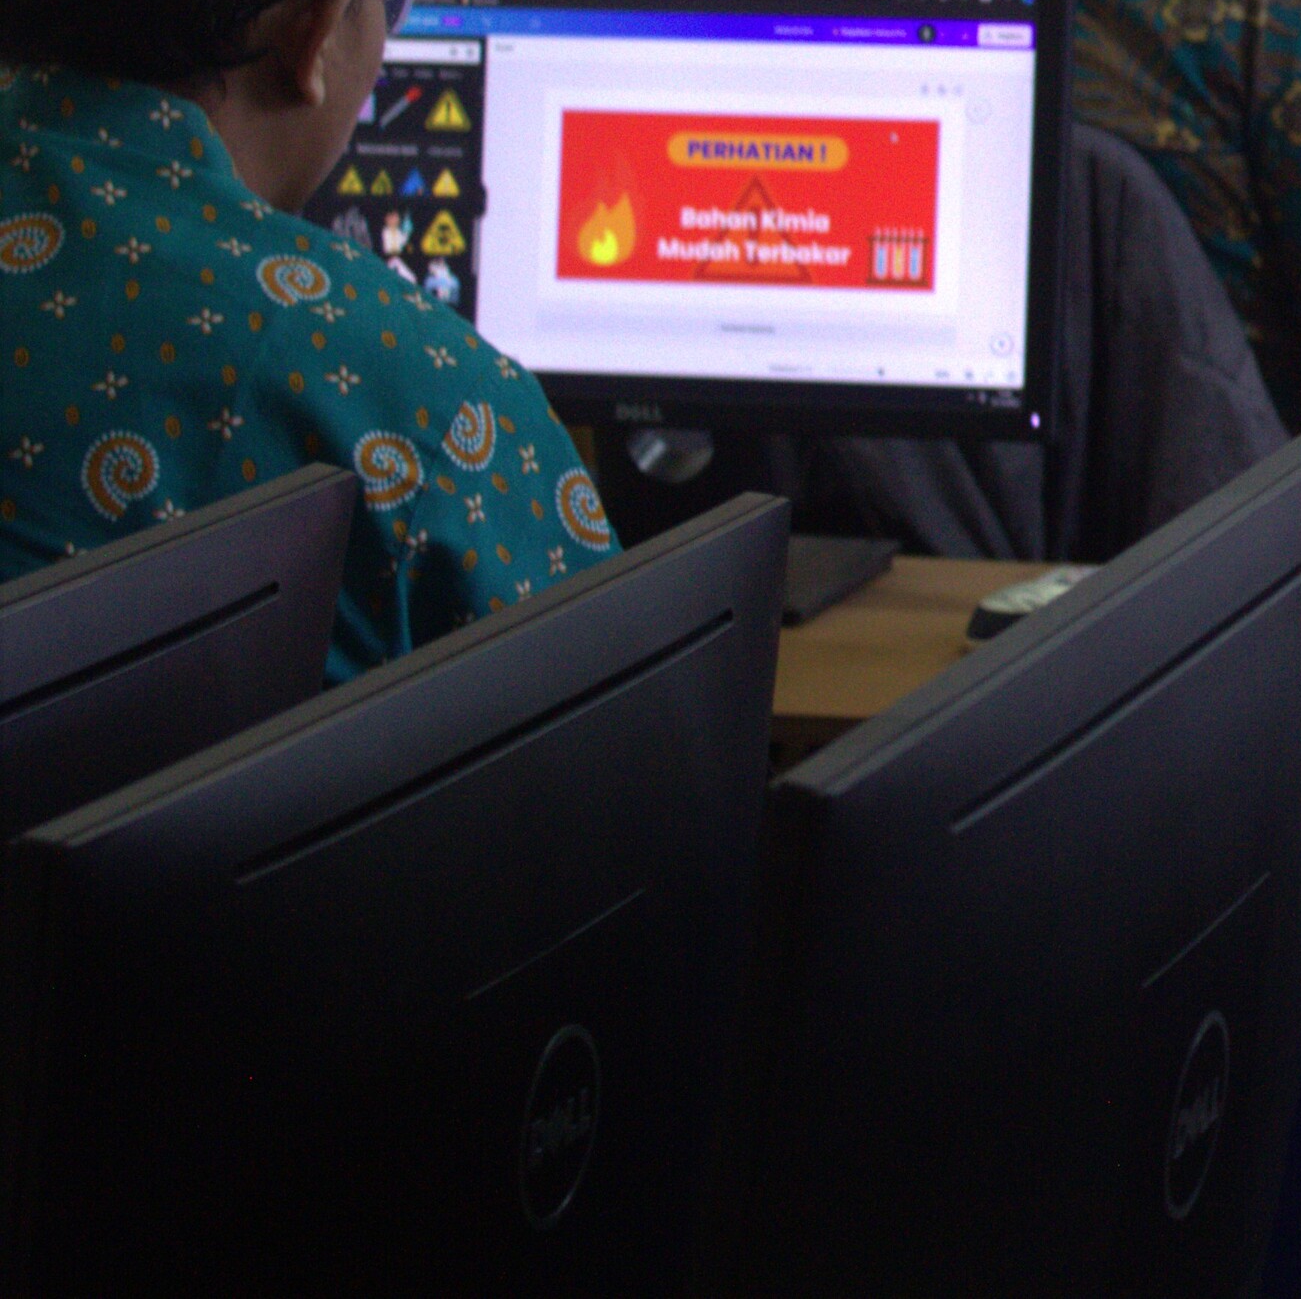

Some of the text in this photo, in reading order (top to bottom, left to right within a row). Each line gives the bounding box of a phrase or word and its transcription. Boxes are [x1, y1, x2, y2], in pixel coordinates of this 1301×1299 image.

[688, 139, 828, 163] PERHATIAN !
[680, 206, 831, 233] Bahan Kimia
[657, 238, 851, 266] Mudah Terbakar
